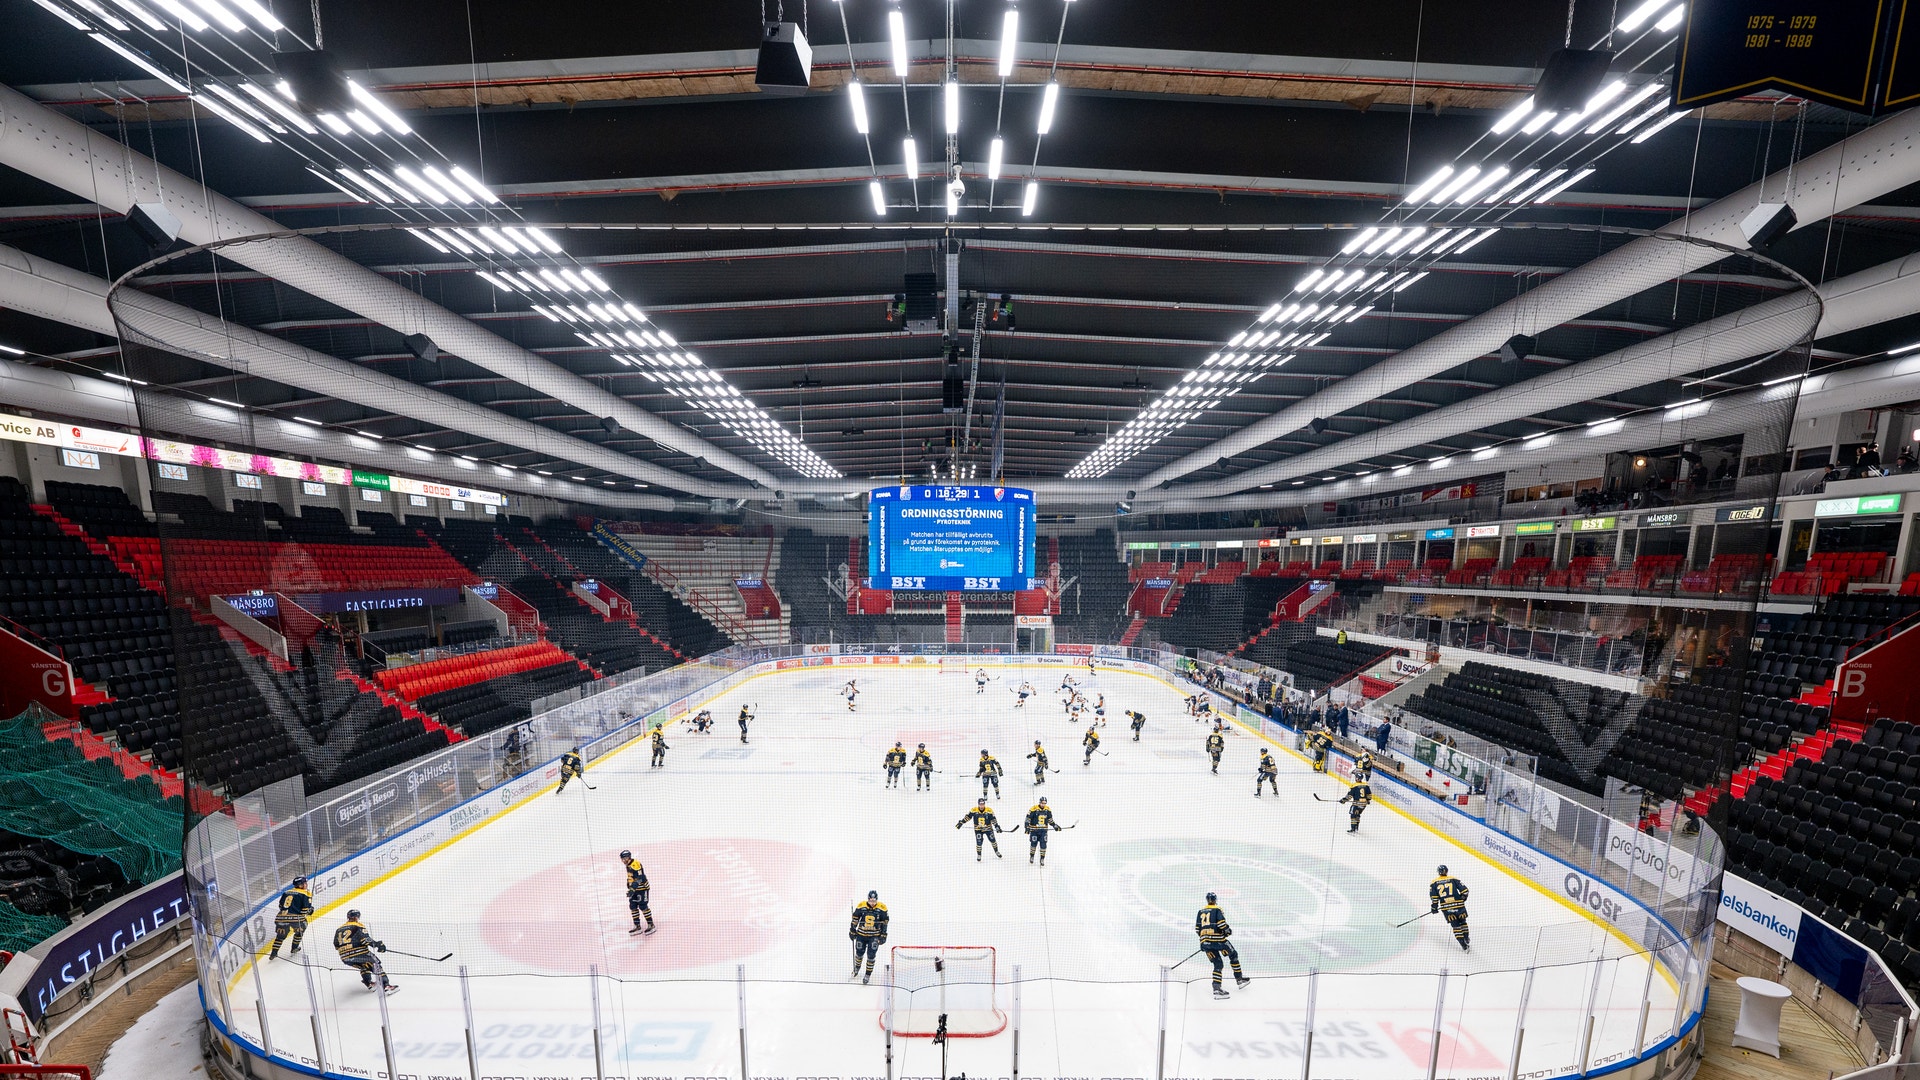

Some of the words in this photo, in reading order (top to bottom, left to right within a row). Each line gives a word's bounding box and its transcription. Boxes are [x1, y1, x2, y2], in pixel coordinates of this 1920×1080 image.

[1747, 16, 1775, 29] 1975
[1789, 16, 1817, 29] 1979
[1745, 35, 1770, 48] 1981
[1785, 35, 1813, 48] 1988
[36, 426, 56, 438] AB
[924, 490, 931, 498] 0
[938, 489, 967, 498] 18:29
[974, 490, 980, 498] 1
[901, 507, 1003, 519] ORDNINGSSTÖRNING
[1646, 514, 1678, 522] MÅNSBRO
[1581, 518, 1605, 530] BST
[594, 523, 643, 562] Sportklubben
[891, 577, 925, 589] BST
[964, 577, 1000, 590] BST
[885, 591, 1015, 603] svensk-entreprenad.se
[621, 604, 630, 615] K
[1278, 604, 1287, 615] A
[811, 645, 831, 653] CWT
[42, 669, 65, 697] G
[1842, 669, 1867, 698] B
[372, 788, 396, 805] Resor
[1484, 836, 1512, 858] Björcks
[1513, 852, 1538, 870] Resor
[1611, 835, 1686, 882] procurator
[340, 865, 360, 883] AB
[1437, 882, 1453, 898] 27
[1564, 872, 1622, 922] Qlosr
[284, 895, 294, 907] 8
[1200, 911, 1211, 927] 21
[242, 914, 267, 954] AB
[337, 929, 352, 946] 12
[480, 1023, 619, 1040] CARGO
[1264, 1020, 1372, 1038] SPEL
[374, 1041, 606, 1060] BROTHERS
[1186, 1040, 1389, 1059] SVENSKA
